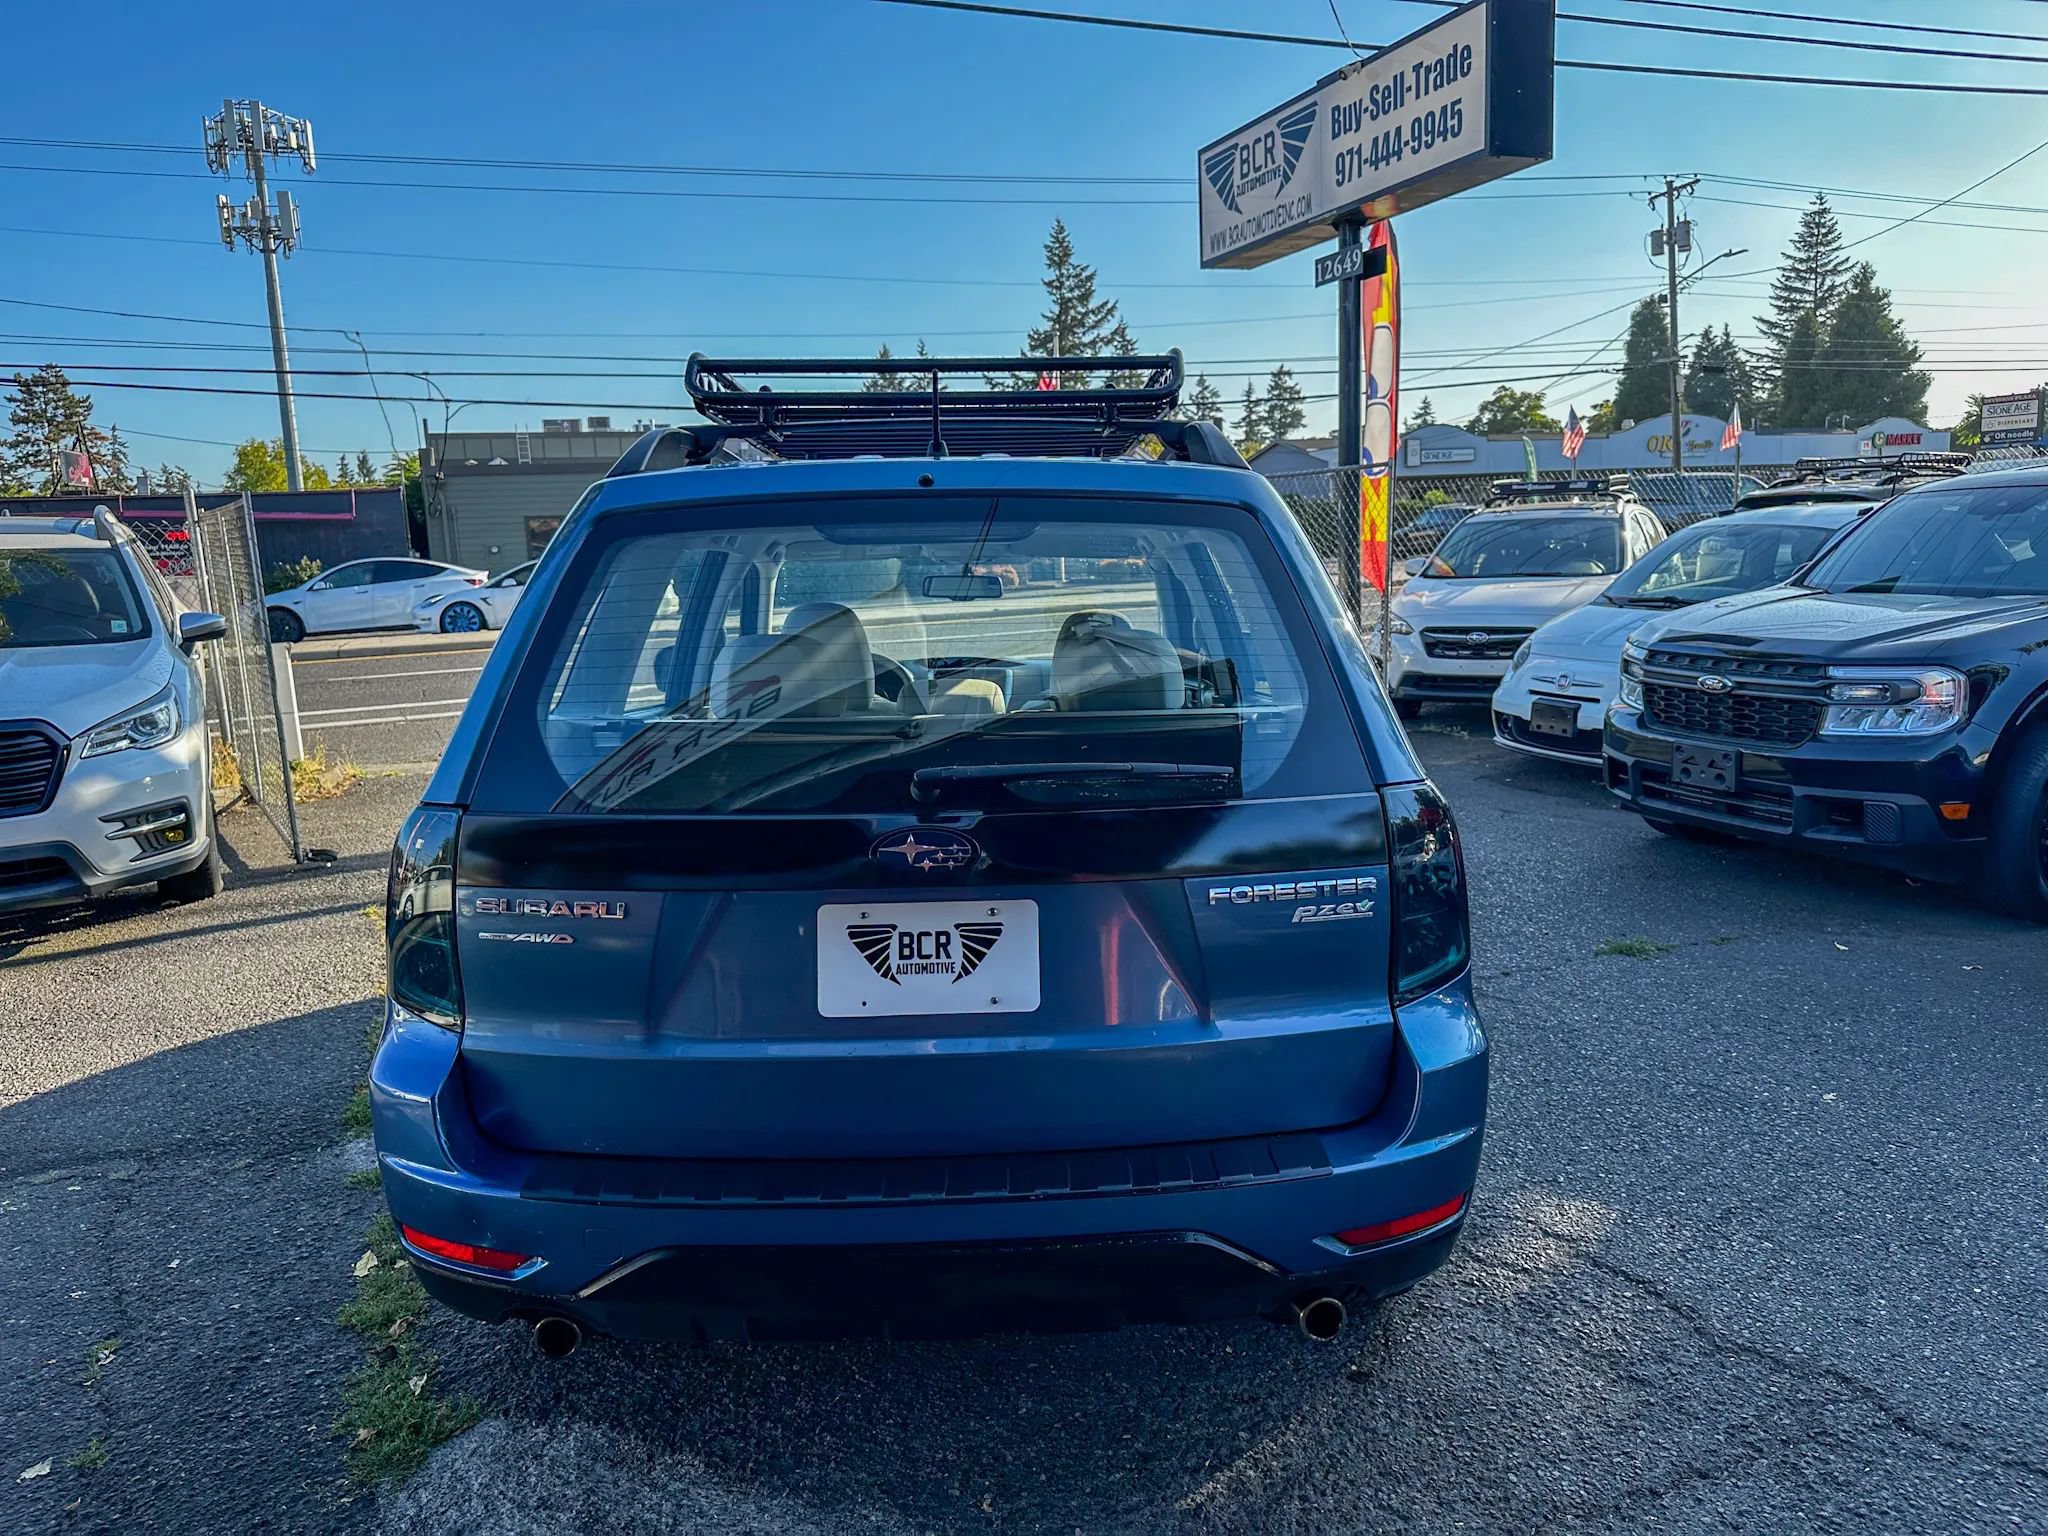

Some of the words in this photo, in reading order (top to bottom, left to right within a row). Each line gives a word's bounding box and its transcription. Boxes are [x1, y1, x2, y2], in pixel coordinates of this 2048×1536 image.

[1331, 43, 1472, 141] Buy-Sell-Trade
[1238, 129, 1276, 179] BCR
[1335, 98, 1463, 188] 971-444-9945
[1236, 164, 1283, 198] AUTOMOTIVE
[1209, 193, 1313, 254] WWW.BCRAUTOMOTIVEINC.COM
[1316, 248, 1362, 281] 12649
[1987, 404, 2014, 416] STONE
[2014, 402, 2032, 413] AGE
[1997, 418, 2034, 426] DISPENSARY
[1994, 432, 2006, 440] OK
[2007, 430, 2034, 438] noodle
[1208, 876, 1378, 906] FORESTER
[476, 897, 626, 919] SUBARU
[513, 932, 575, 945] AWD
[898, 931, 952, 961] BCR
[895, 962, 956, 976] AUTOMOTIVE
